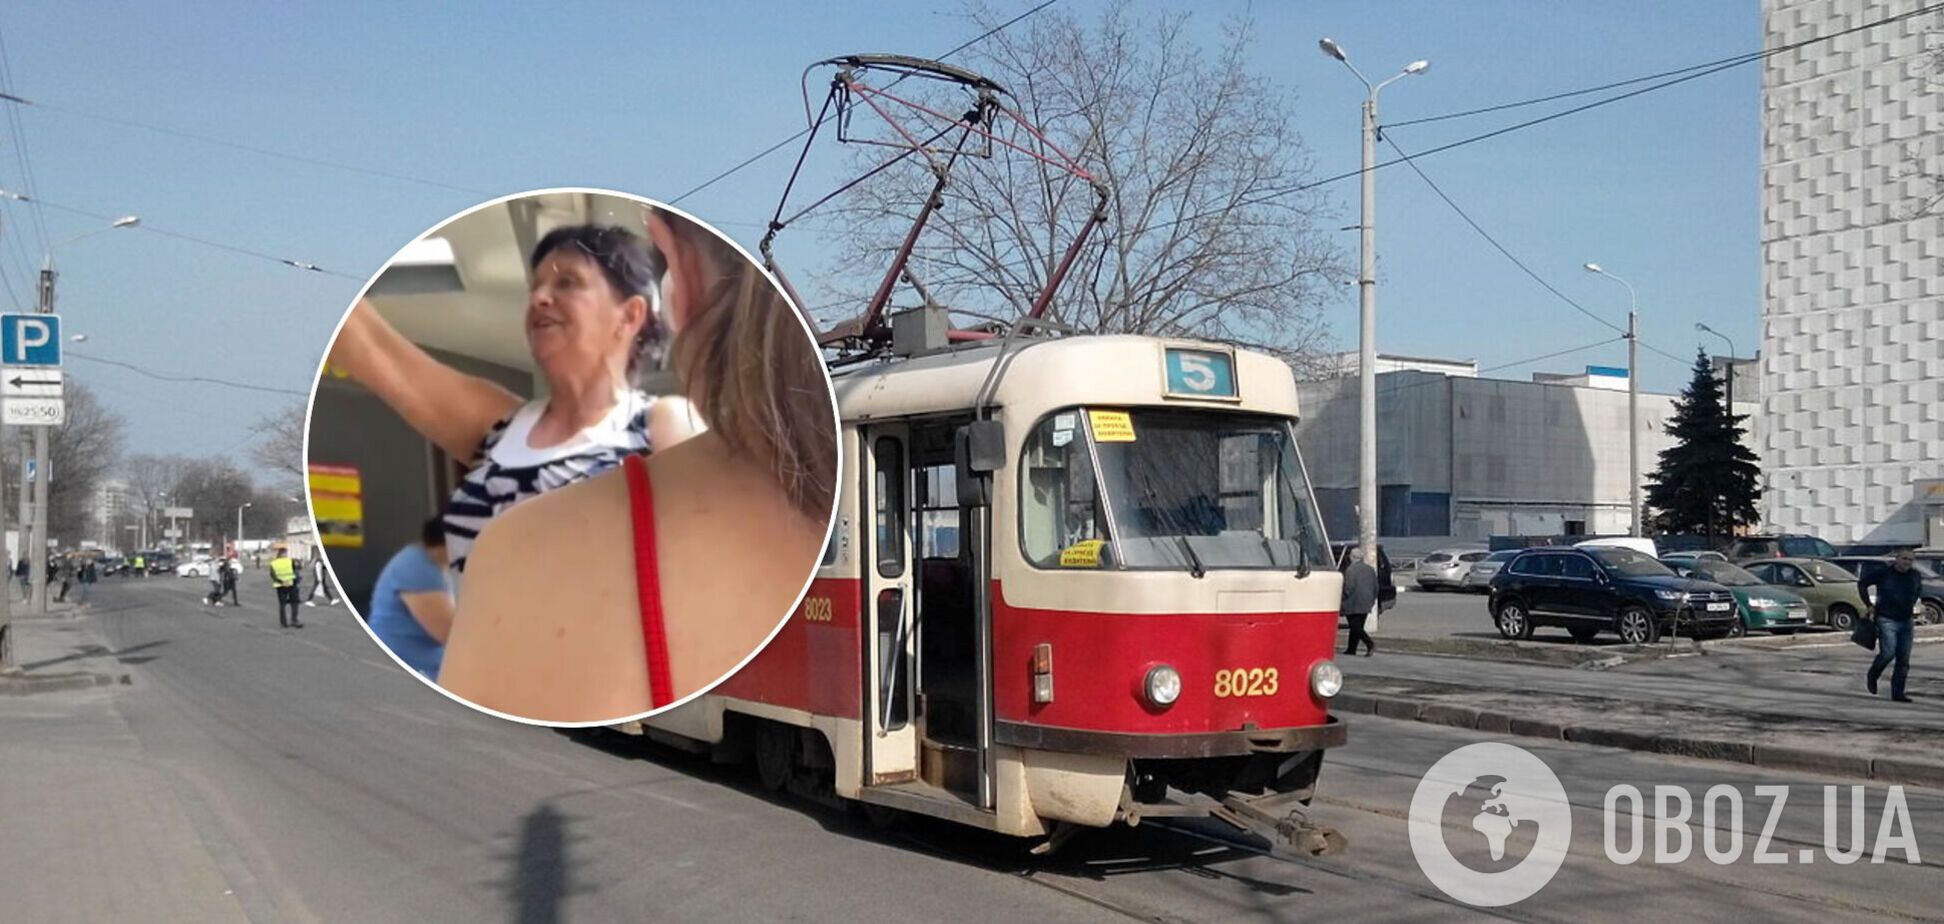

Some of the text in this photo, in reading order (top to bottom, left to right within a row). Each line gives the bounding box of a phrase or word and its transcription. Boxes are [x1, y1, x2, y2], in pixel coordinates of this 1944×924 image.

[17, 319, 50, 361] P
[1179, 352, 1216, 392] 5
[805, 598, 832, 622] 8023
[1214, 667, 1279, 698] 8023
